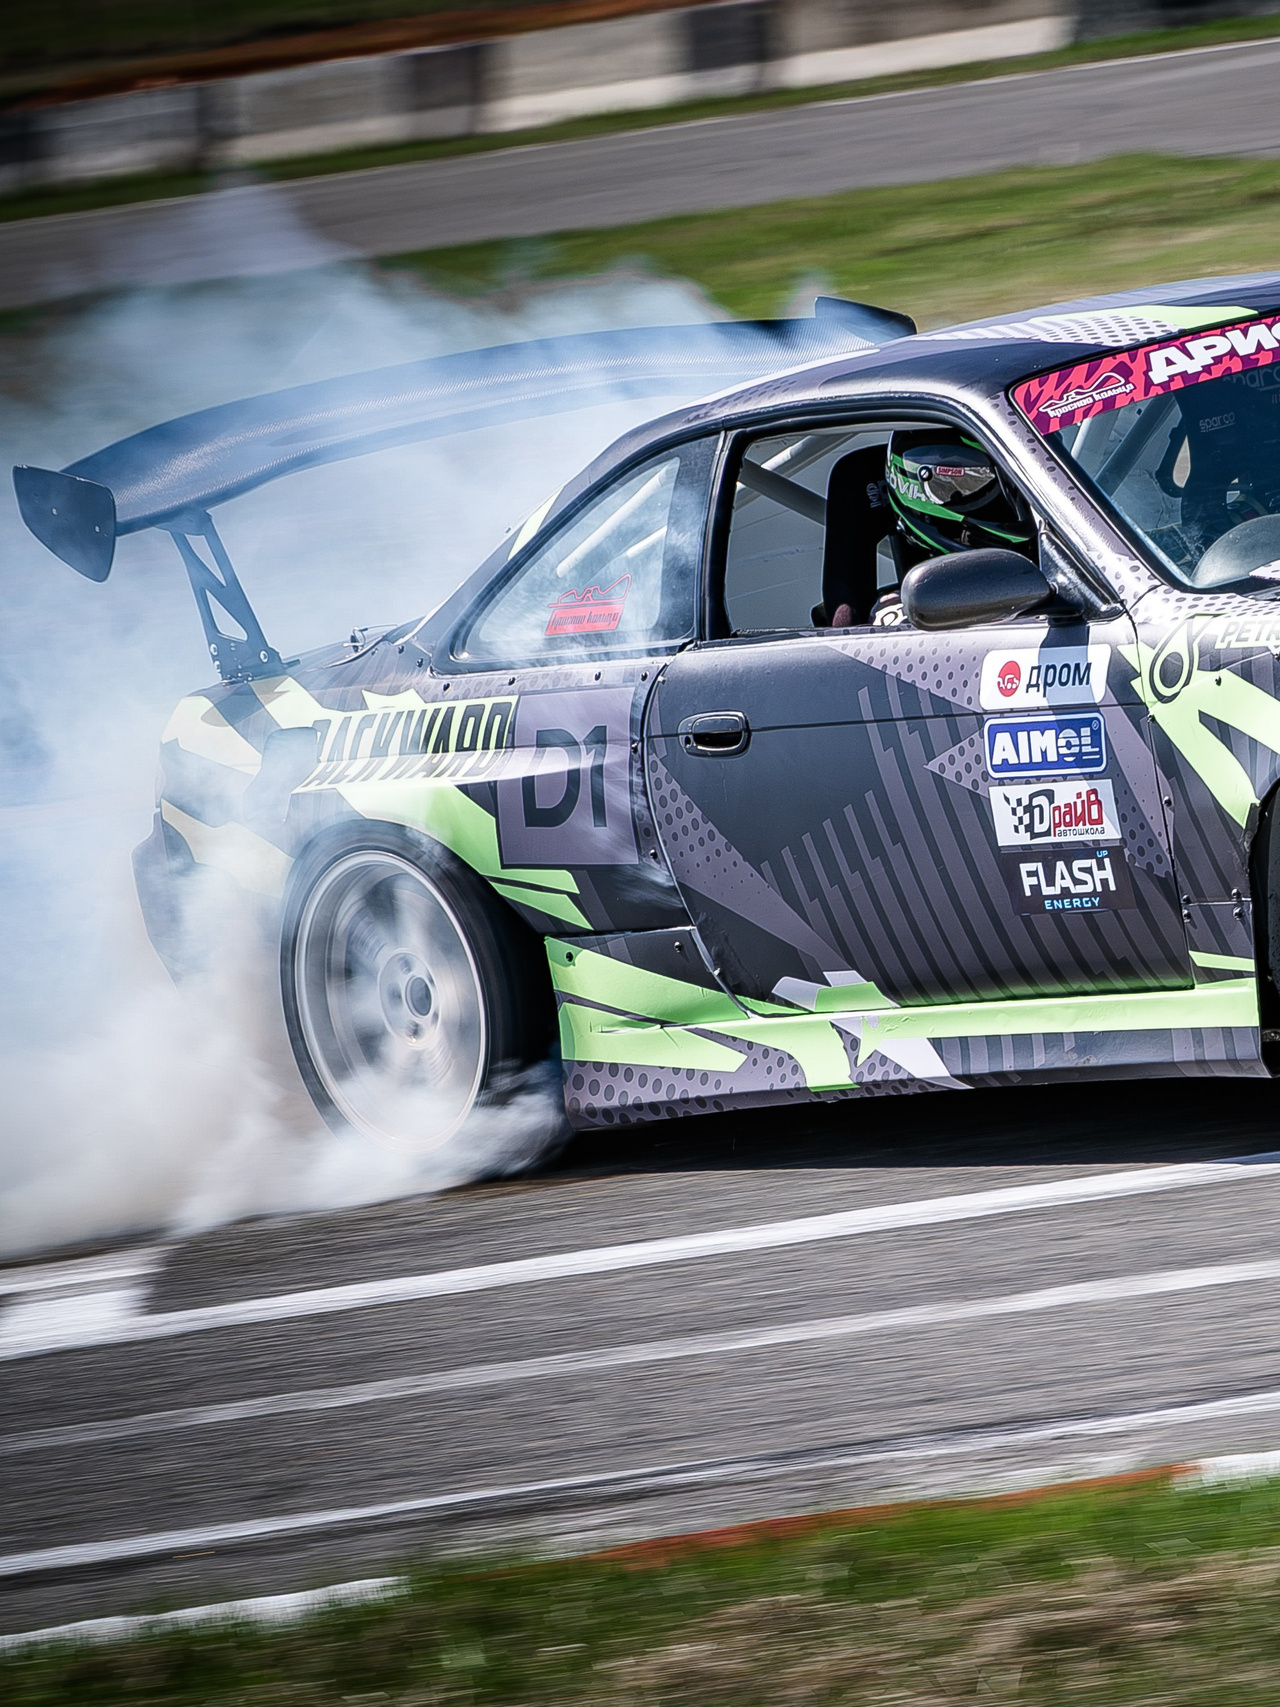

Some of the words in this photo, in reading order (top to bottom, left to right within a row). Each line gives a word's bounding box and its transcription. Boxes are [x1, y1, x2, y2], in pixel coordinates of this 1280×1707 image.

[938, 466, 963, 476] SIMPSON
[991, 727, 1101, 766] AIMOL
[521, 725, 608, 828] D1
[1057, 826, 1106, 838] автошкола
[1096, 850, 1109, 858] UP
[1019, 857, 1117, 897] FLASH
[1044, 897, 1100, 910] ENERGY
